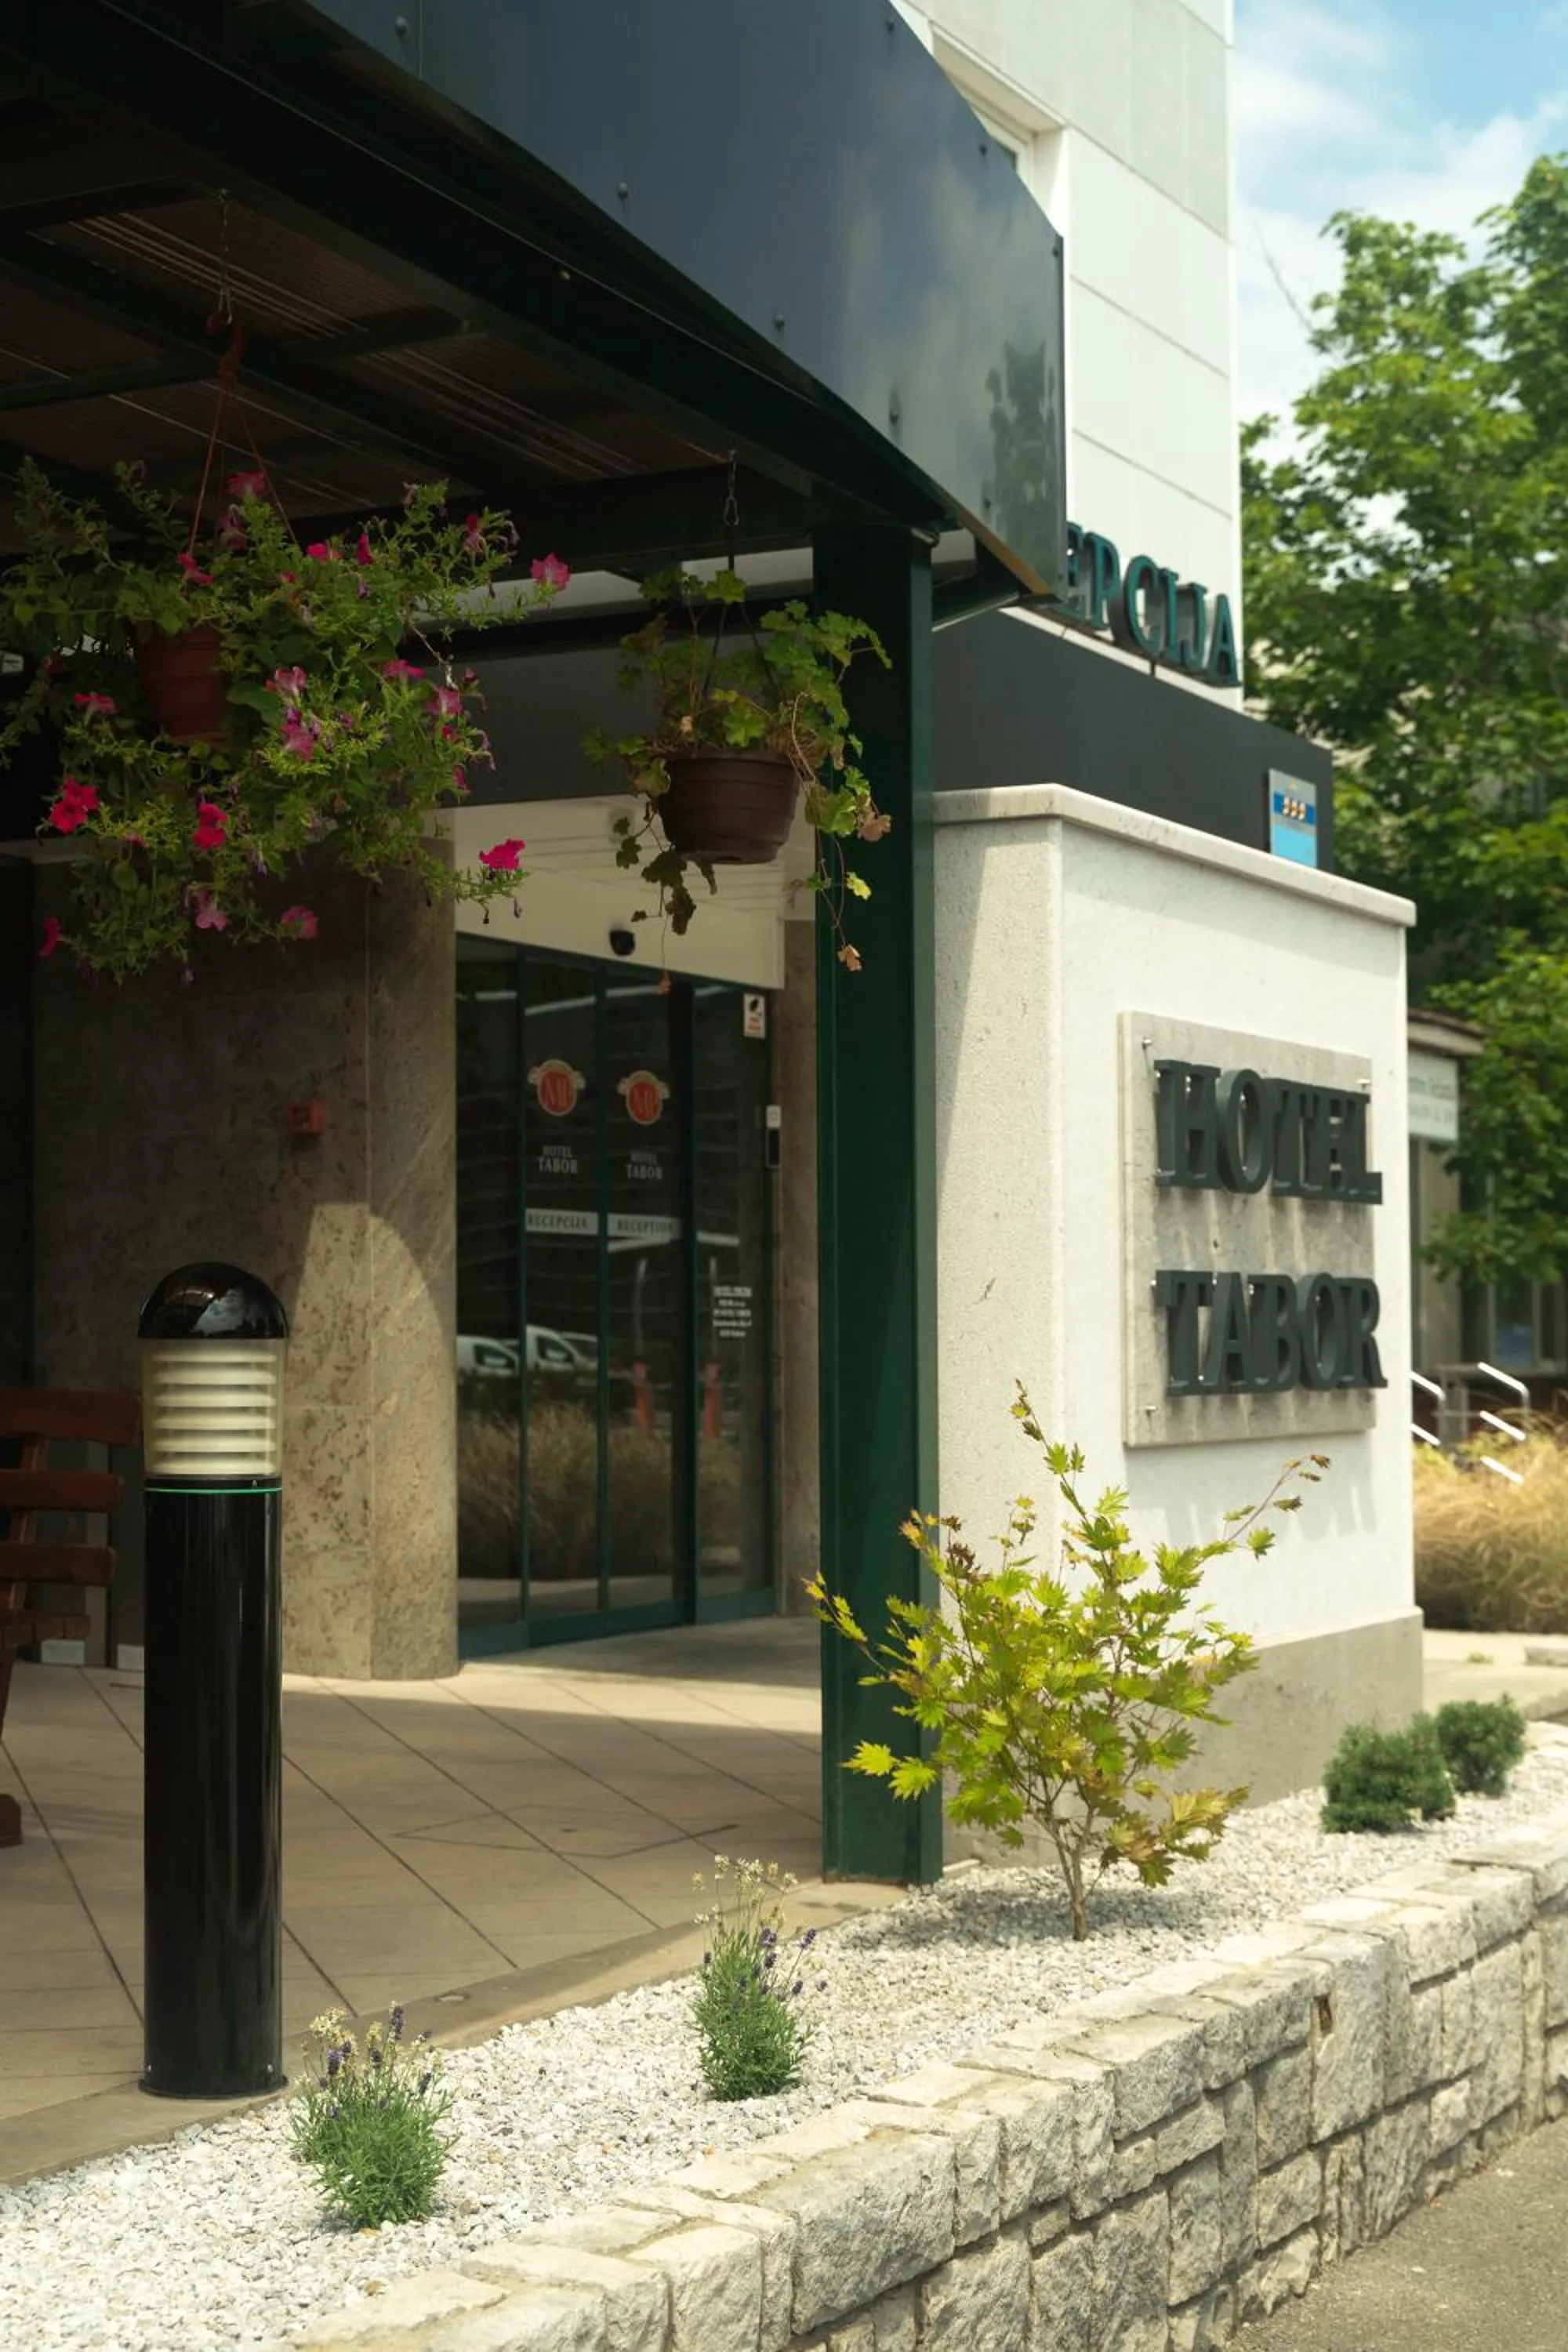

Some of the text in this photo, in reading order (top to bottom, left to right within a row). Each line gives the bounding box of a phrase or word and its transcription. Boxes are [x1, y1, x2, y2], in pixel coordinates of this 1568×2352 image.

[1154, 1059, 1383, 1205] HOTEL
[543, 1145, 573, 1158] HOTEL
[538, 1156, 577, 1174] TABOR
[626, 1165, 662, 1180] TABOR
[528, 1214, 587, 1229] RECEPCIJA
[1156, 1270, 1388, 1396] TABOR
